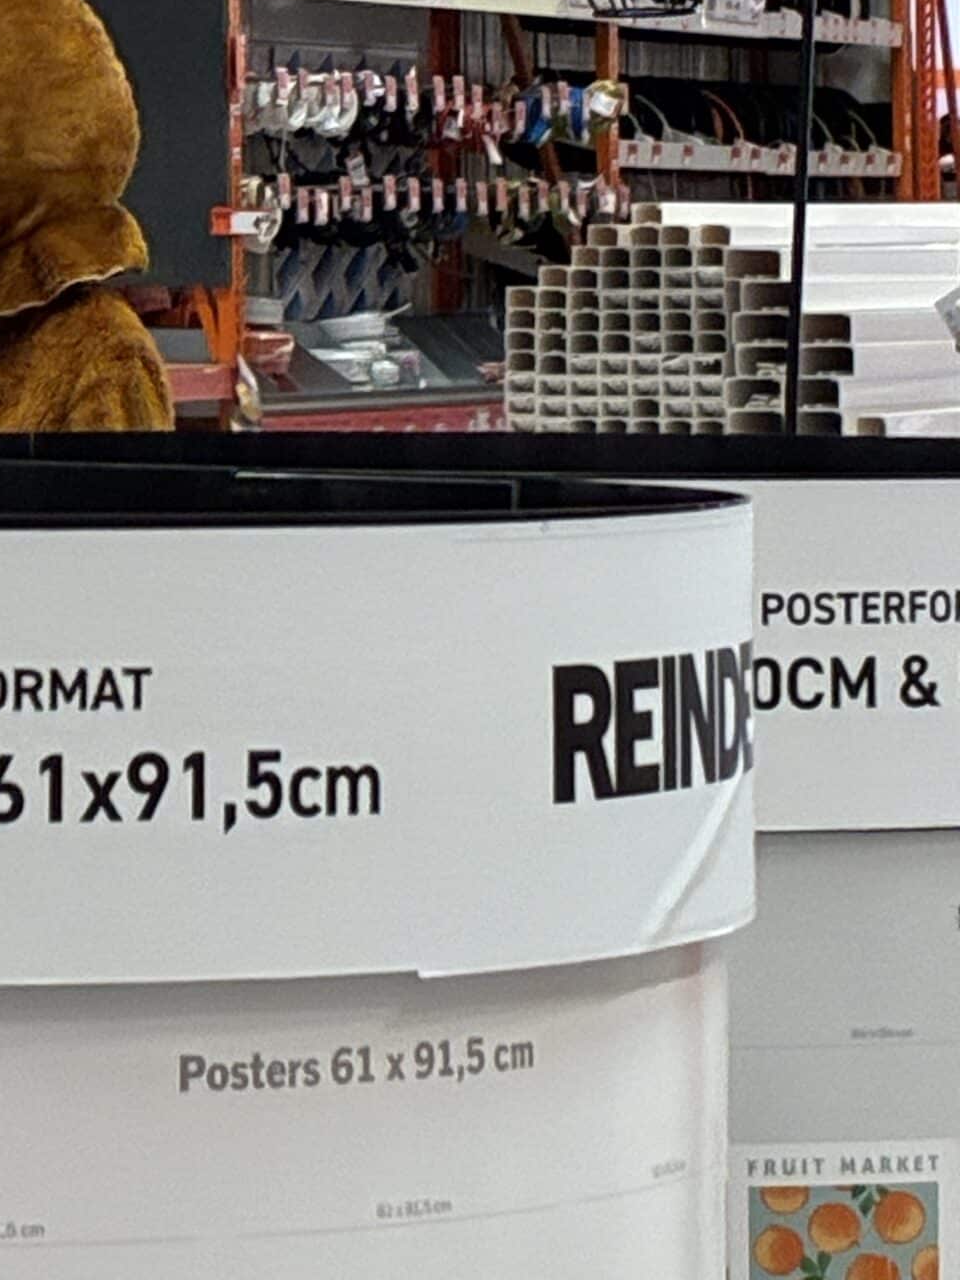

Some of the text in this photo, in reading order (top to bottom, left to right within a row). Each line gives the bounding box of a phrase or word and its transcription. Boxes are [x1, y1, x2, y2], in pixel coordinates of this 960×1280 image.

[899, 654, 941, 709] &
[178, 1035, 534, 1093] Posters 61 x 91,5 cm
[746, 1153, 940, 1178] FRUIT MARKET
